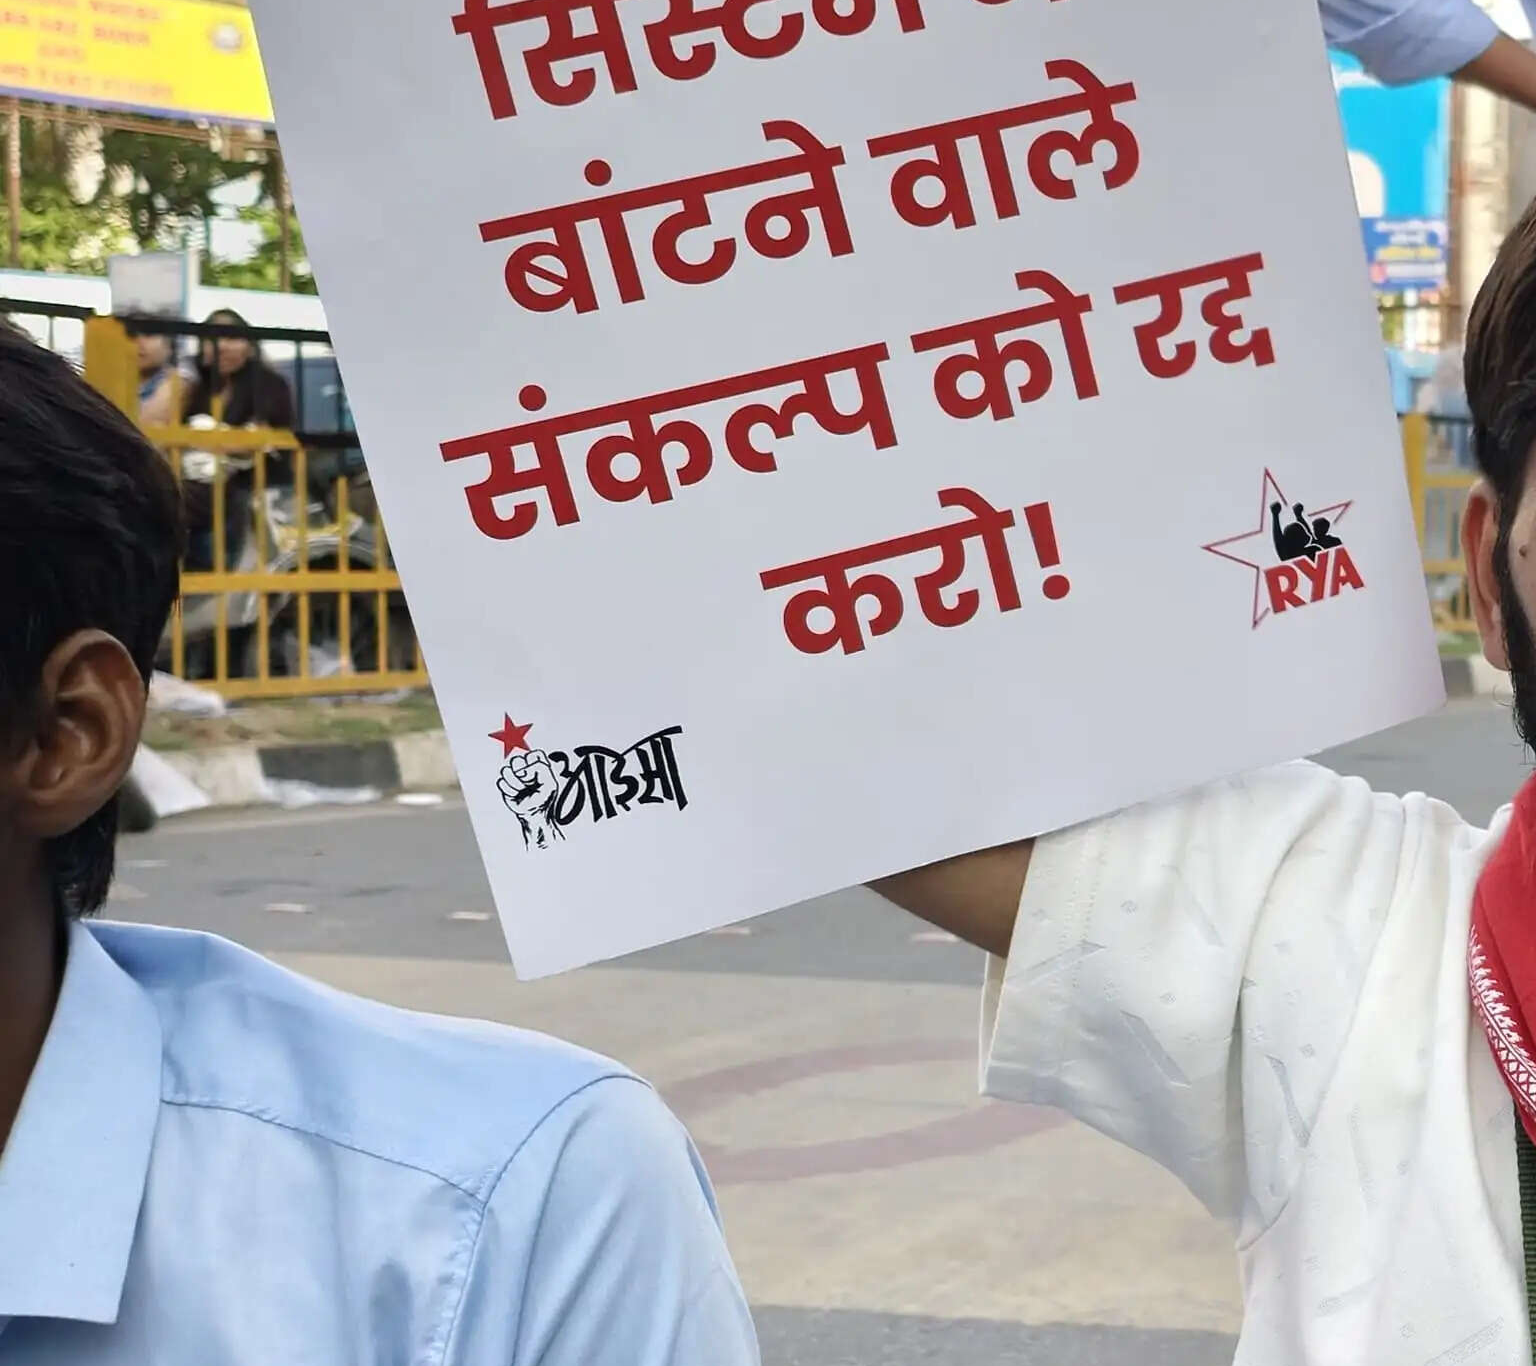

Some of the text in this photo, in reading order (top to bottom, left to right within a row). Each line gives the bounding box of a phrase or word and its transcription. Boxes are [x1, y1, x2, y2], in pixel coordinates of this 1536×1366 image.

[478, 58, 1140, 315] बांटने वाले
[438, 252, 1278, 541] संकल्प को रद्द
[759, 487, 1072, 656] करो!
[1263, 546, 1366, 615] RYA
